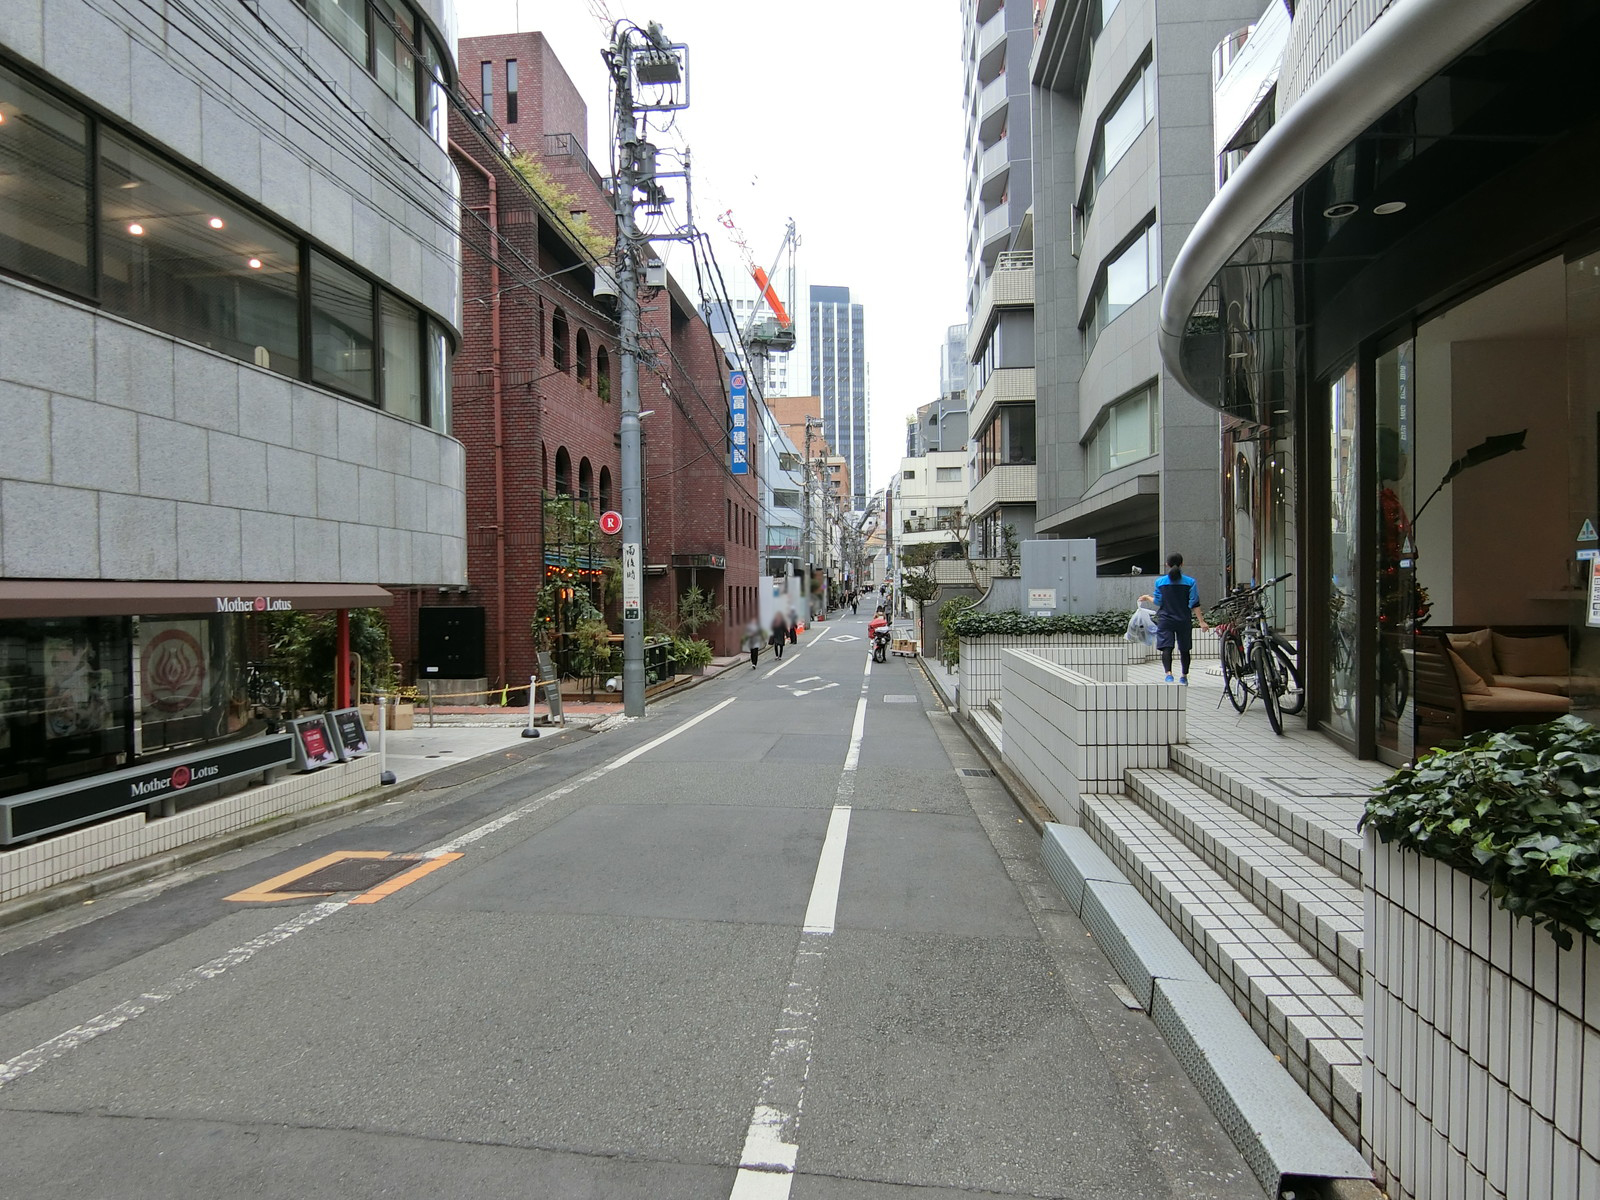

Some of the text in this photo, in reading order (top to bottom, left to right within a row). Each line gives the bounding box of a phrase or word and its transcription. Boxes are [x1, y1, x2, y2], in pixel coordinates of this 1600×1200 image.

[607, 517, 614, 528] R
[216, 596, 292, 613] Mother Lotus
[130, 765, 219, 797] Mother Lotus
